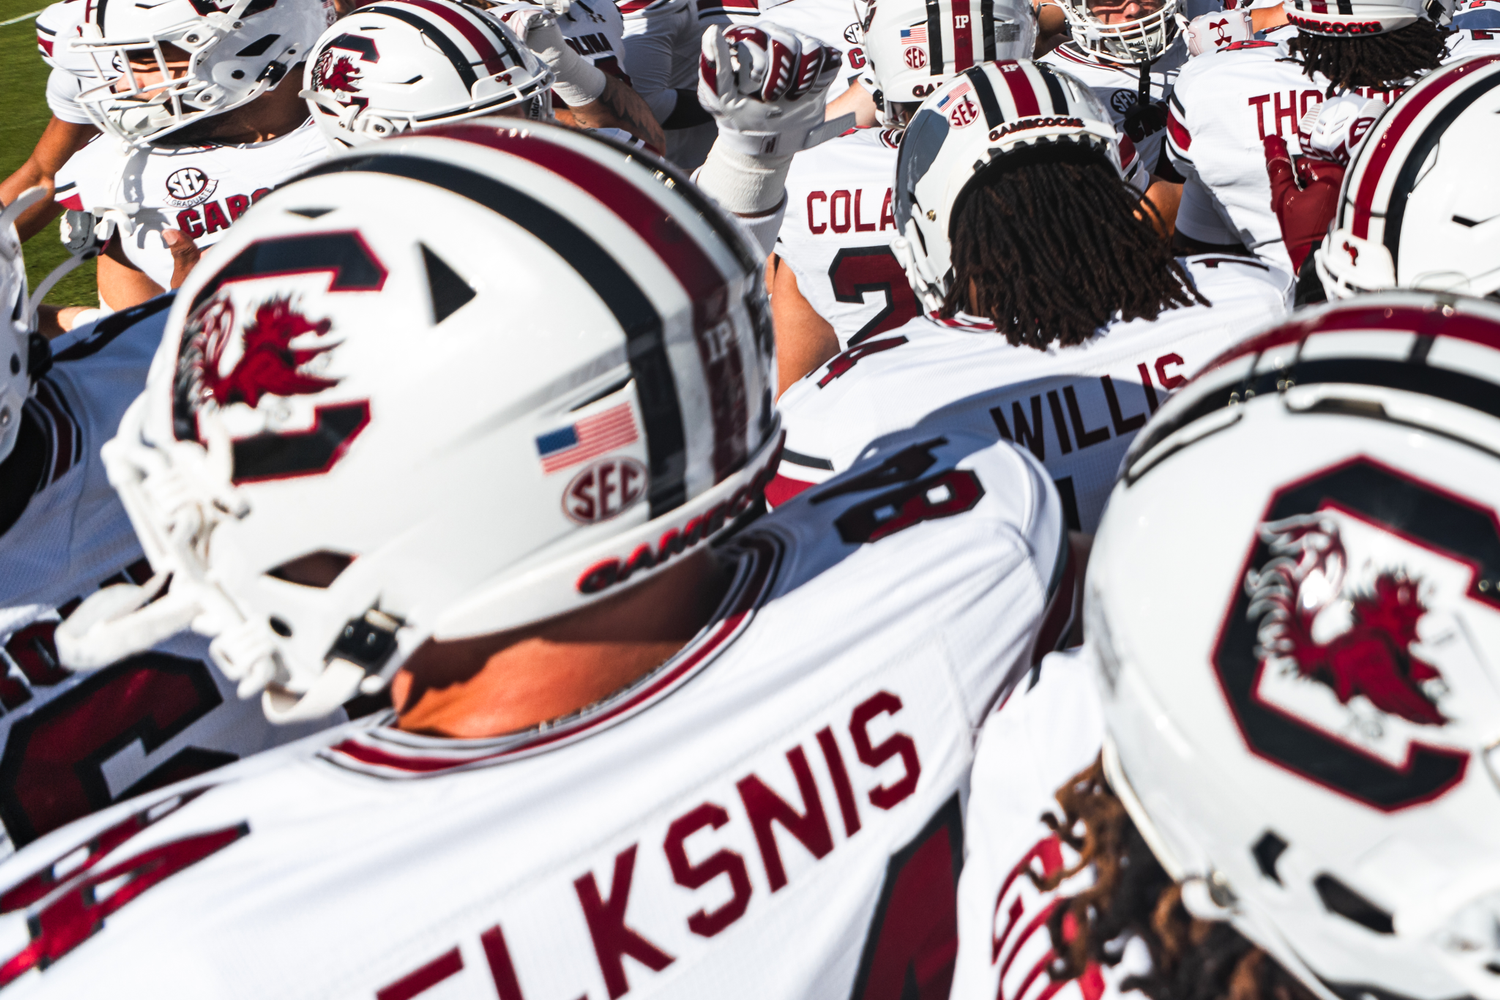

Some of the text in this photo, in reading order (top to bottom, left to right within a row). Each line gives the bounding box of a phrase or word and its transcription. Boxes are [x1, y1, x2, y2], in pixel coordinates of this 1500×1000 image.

[955, 15, 970, 29] IP
[905, 48, 926, 70] SEC
[1000, 63, 1020, 74] IP
[951, 101, 979, 127] SEC
[166, 168, 206, 199] SEC
[172, 187, 214, 208] GRADUATE
[703, 319, 732, 362] IP
[989, 352, 1188, 464] WILLIS
[571, 461, 641, 521] SEC
[374, 690, 923, 1000] LKSNIS
